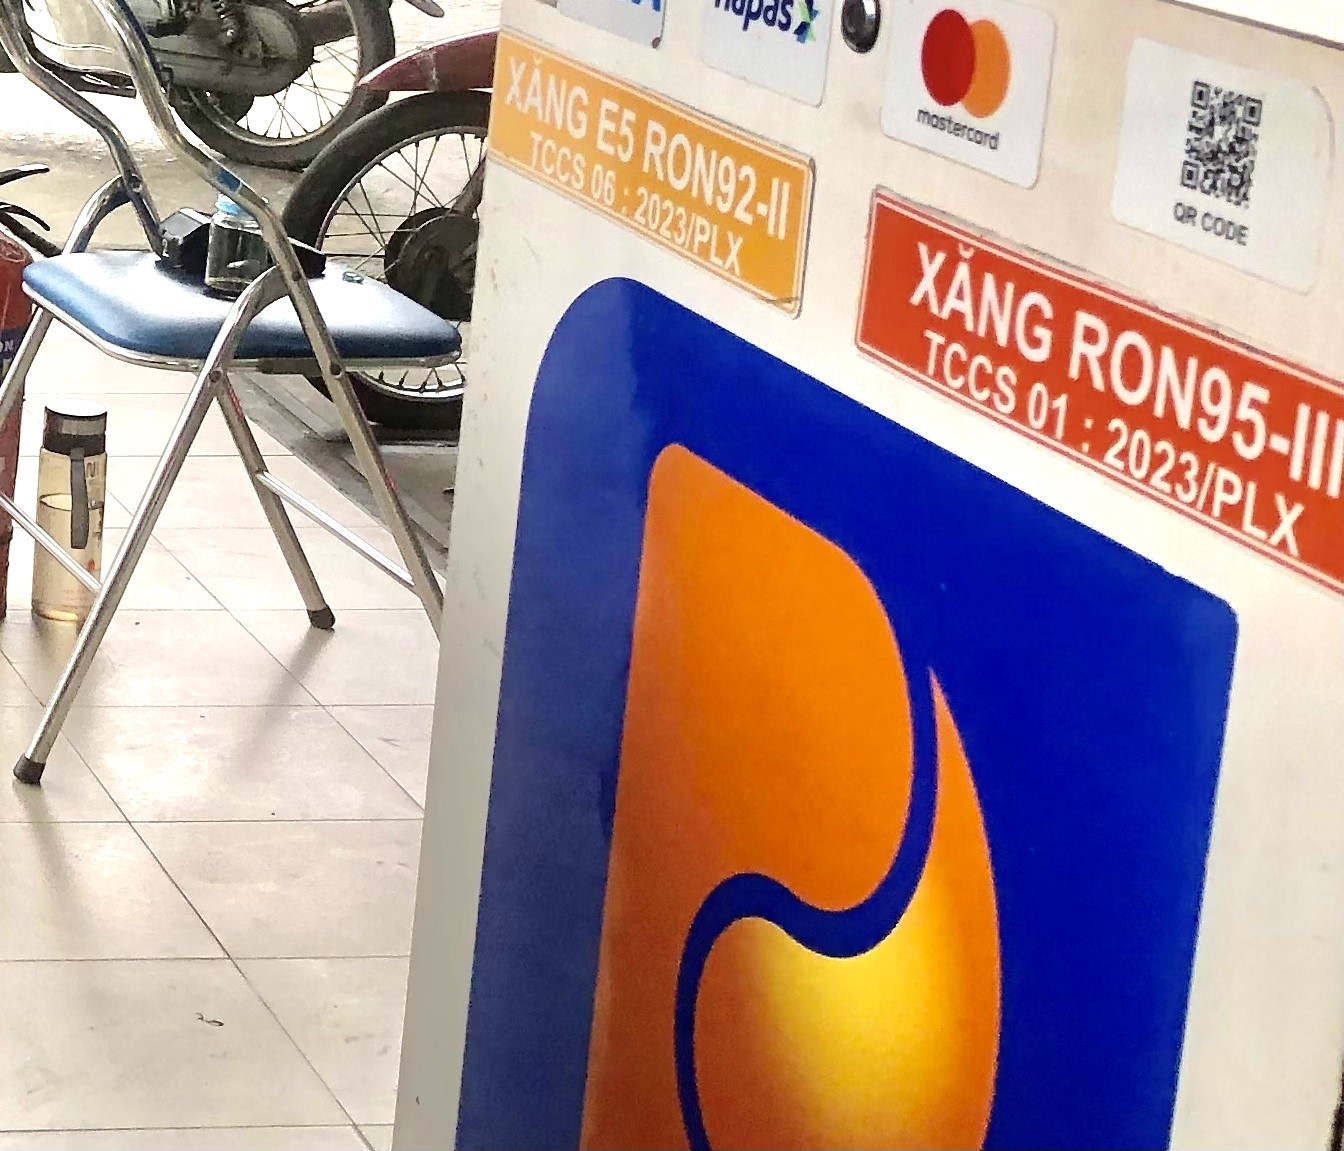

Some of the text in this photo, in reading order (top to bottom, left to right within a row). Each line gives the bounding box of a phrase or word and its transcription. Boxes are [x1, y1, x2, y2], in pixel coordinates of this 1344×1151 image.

[505, 56, 790, 240] XĂNG E5 RON92-II
[530, 131, 586, 191] TCCS
[590, 164, 616, 206] 06
[635, 186, 744, 277] 2023/PLX
[917, 108, 1000, 150] mastercard
[1173, 202, 1249, 246] QR CODE
[909, 242, 1344, 499] XĂNG RON95-III
[924, 330, 1018, 415] TCCS
[1027, 382, 1068, 440] 01
[1104, 417, 1305, 556] 2023/PLX
